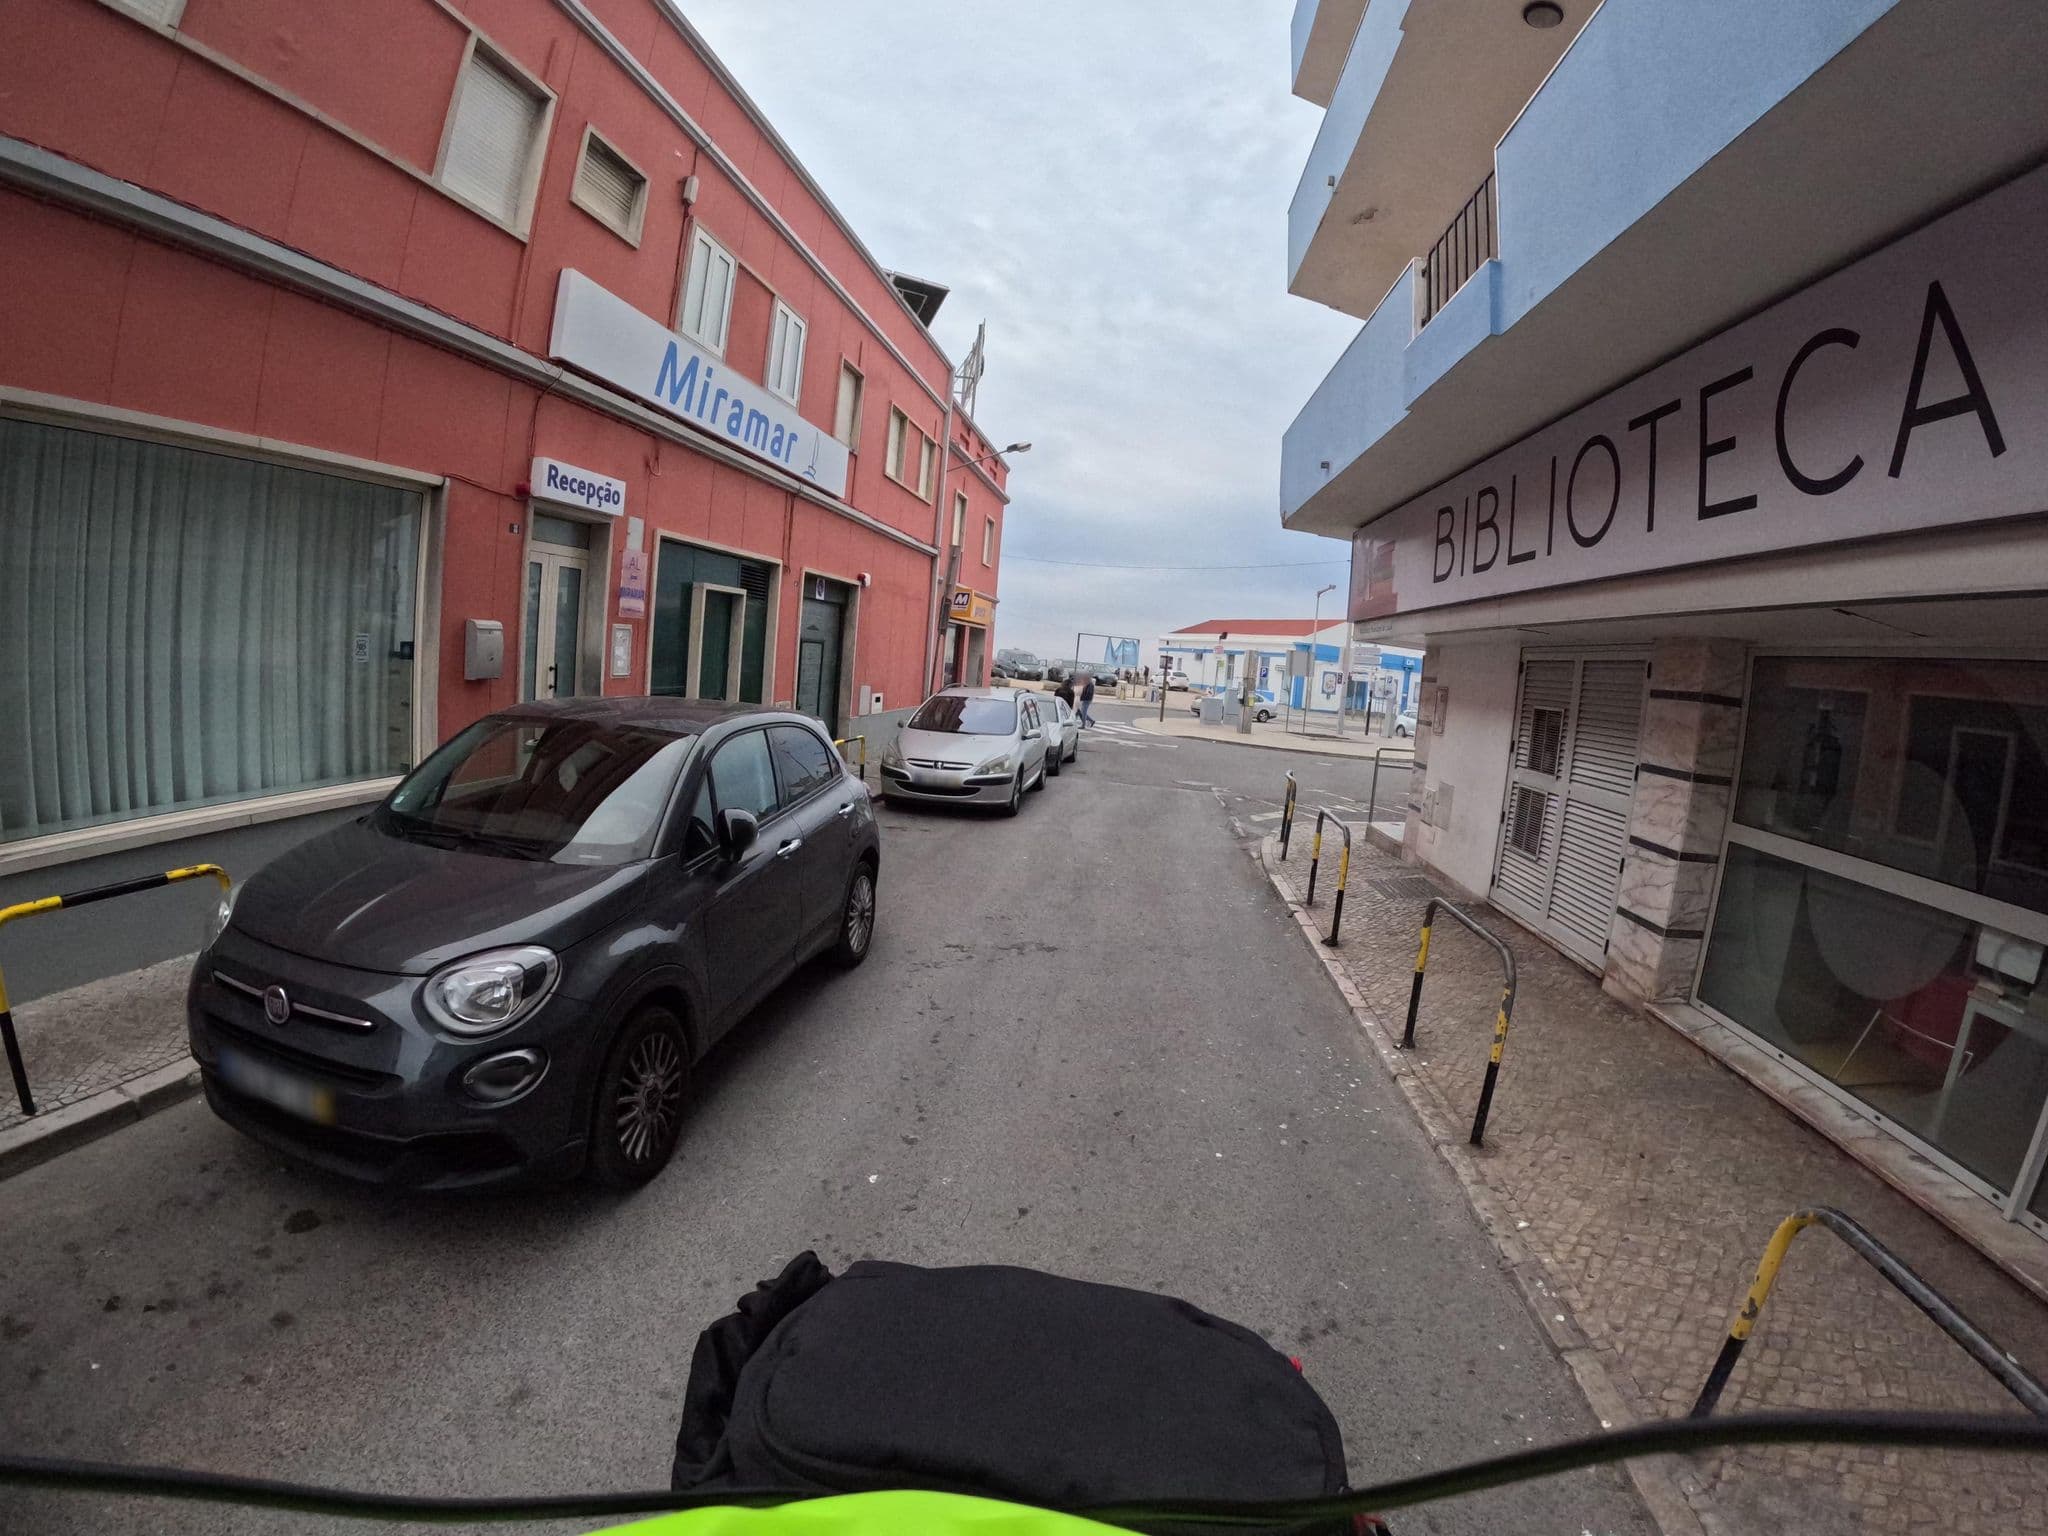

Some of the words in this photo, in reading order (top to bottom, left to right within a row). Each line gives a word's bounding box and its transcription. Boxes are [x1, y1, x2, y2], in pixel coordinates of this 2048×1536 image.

[654, 340, 799, 464] Miramar
[1433, 280, 2008, 584] BIBLIOTECA
[547, 463, 621, 507] Recepção
